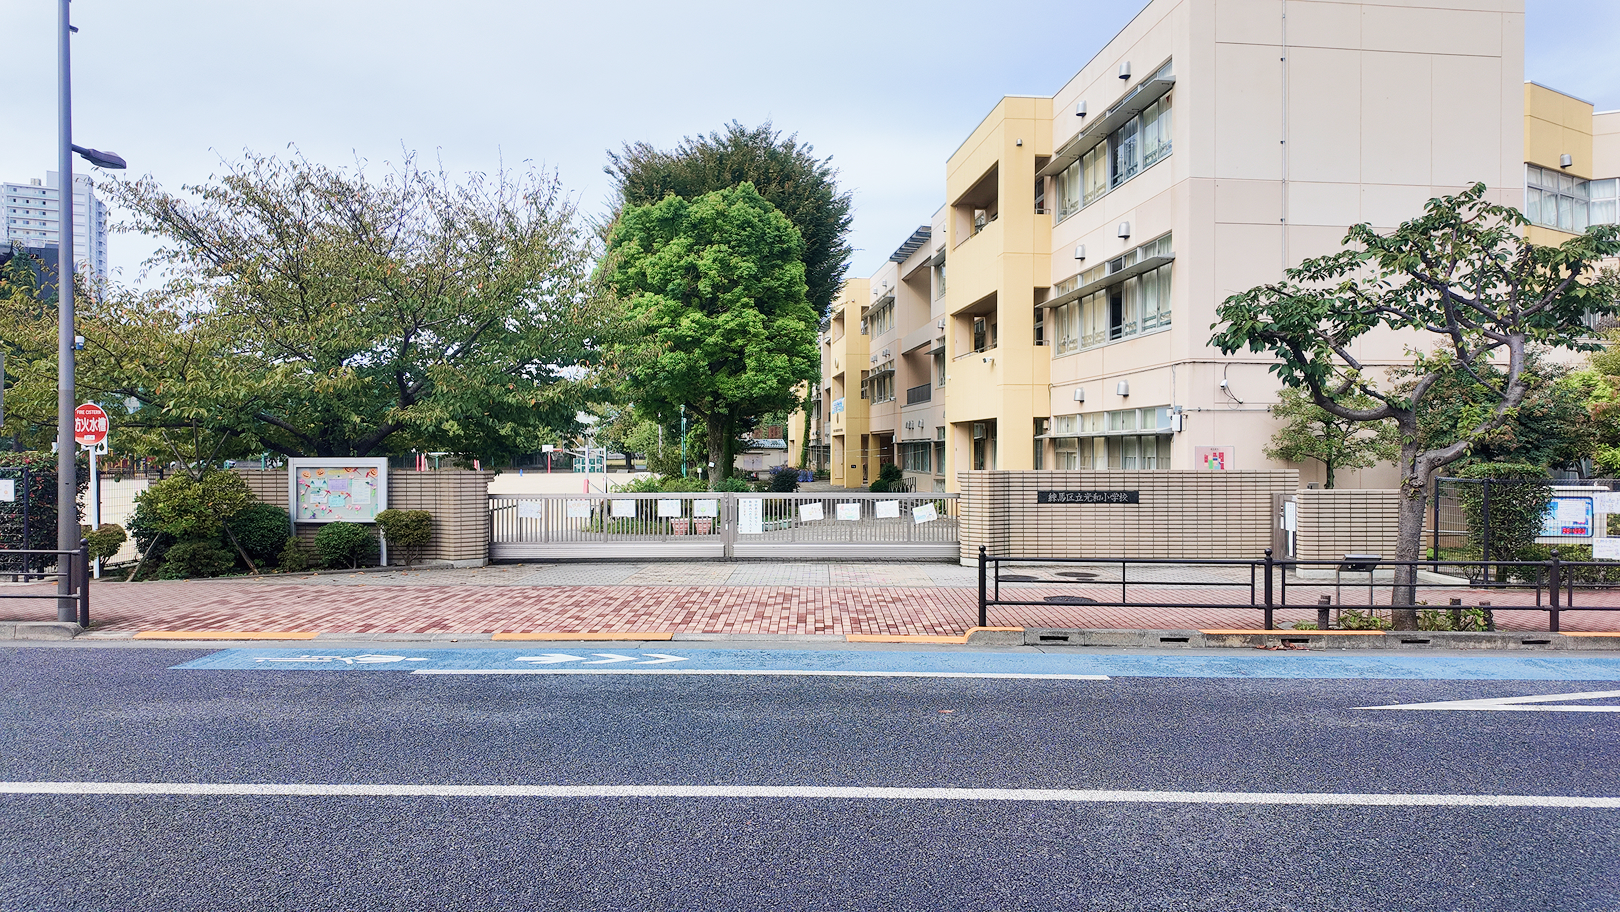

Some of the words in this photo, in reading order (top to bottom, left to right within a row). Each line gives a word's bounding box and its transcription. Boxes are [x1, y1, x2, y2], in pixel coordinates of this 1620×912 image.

[1047, 492, 1129, 503] 練馬区立光和小学校
